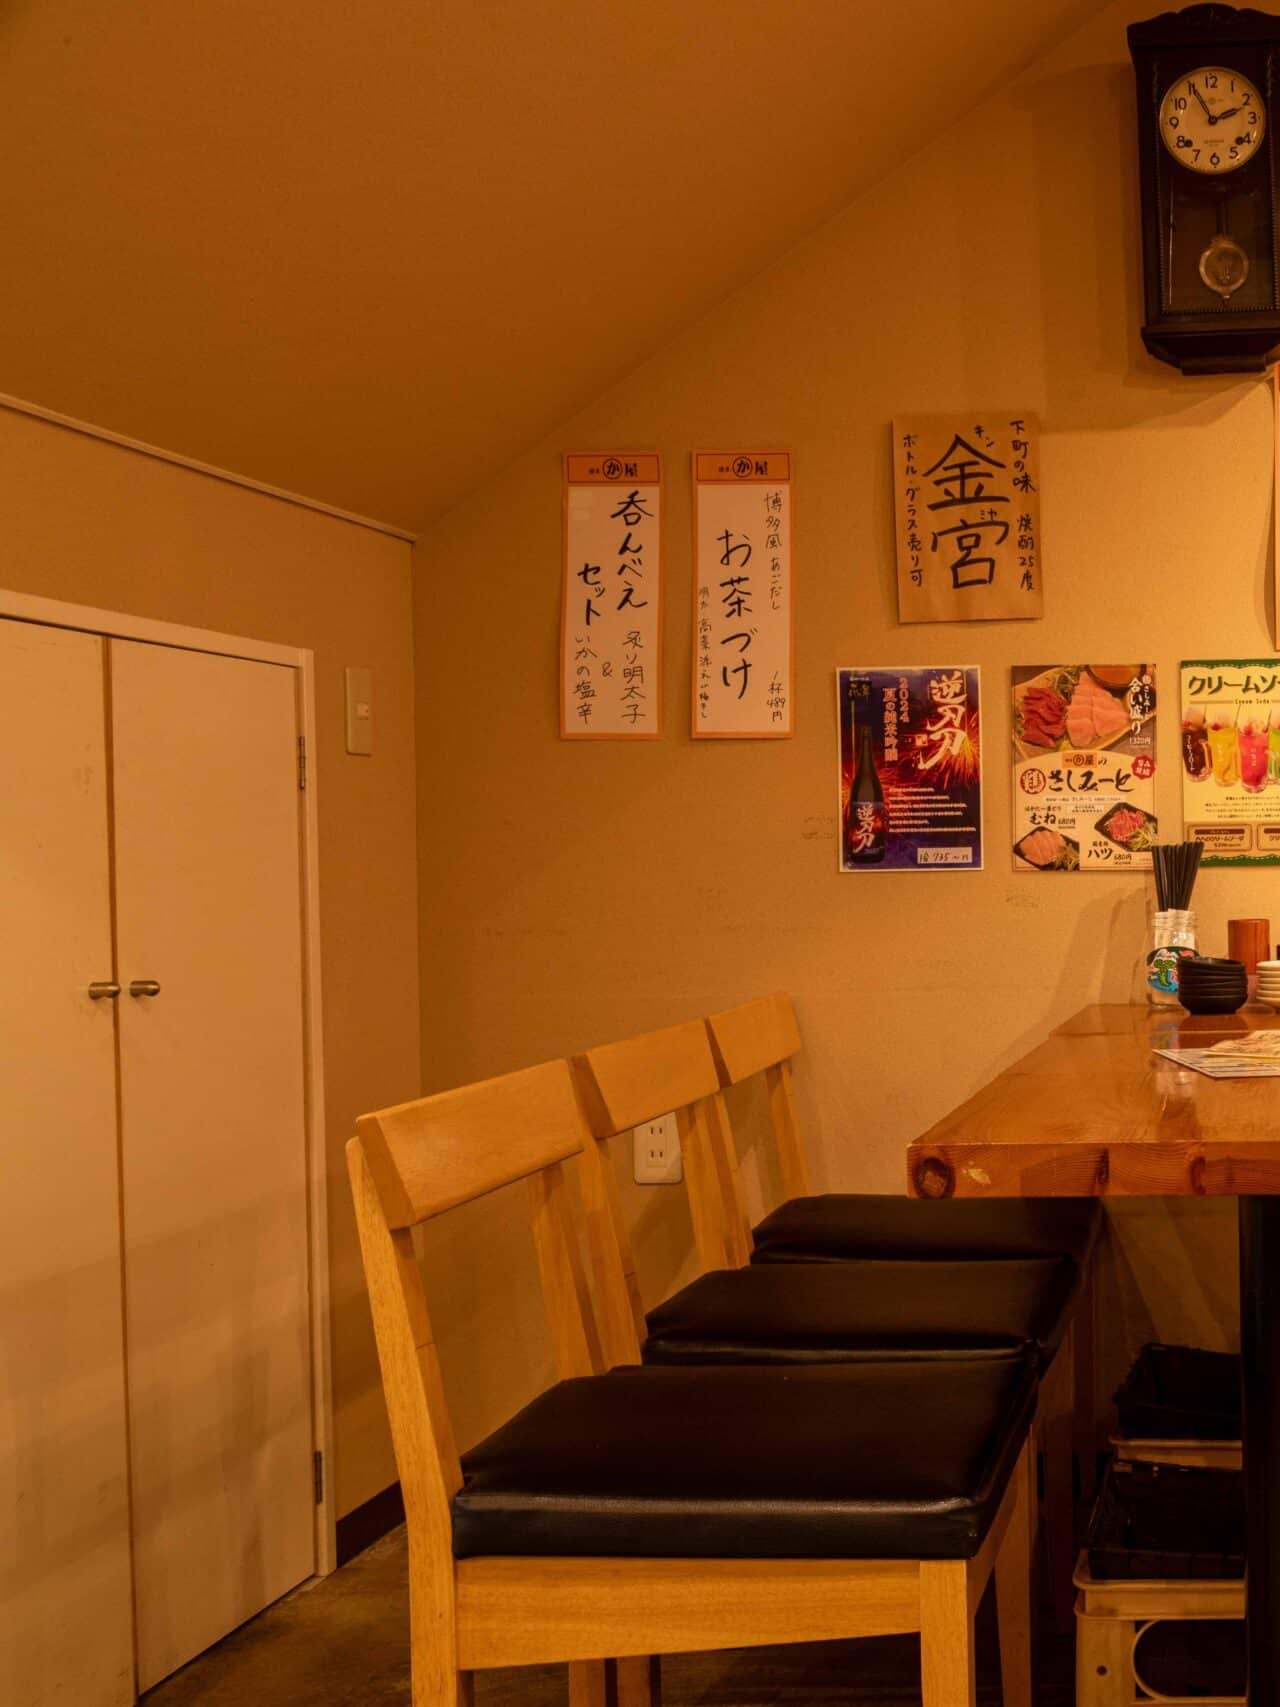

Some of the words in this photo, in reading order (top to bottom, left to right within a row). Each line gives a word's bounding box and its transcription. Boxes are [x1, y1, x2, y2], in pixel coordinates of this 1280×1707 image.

[1205, 75, 1218, 89] 12
[1174, 97, 1187, 111] 10
[1241, 93, 1250, 106] 2
[1169, 117, 1179, 129] 9
[1248, 112, 1257, 125] 3
[1176, 136, 1185, 149] 8
[1192, 149, 1201, 162] 7
[1210, 153, 1220, 165] 6
[1229, 147, 1238, 159] 5
[973, 424, 995, 448] キン
[1009, 420, 1037, 494] 下町の味
[921, 433, 1011, 590] 金宮
[979, 507, 998, 522] ミヤ
[610, 489, 655, 611] 呑んべえ
[1016, 514, 1035, 592] 焼酎25度
[577, 563, 606, 626] セット
[716, 529, 757, 700] お茶づけ
[601, 661, 613, 679] &
[620, 630, 647, 725] 炙り明太子
[572, 635, 598, 725] いかの塩辛
[899, 677, 911, 724] 2024
